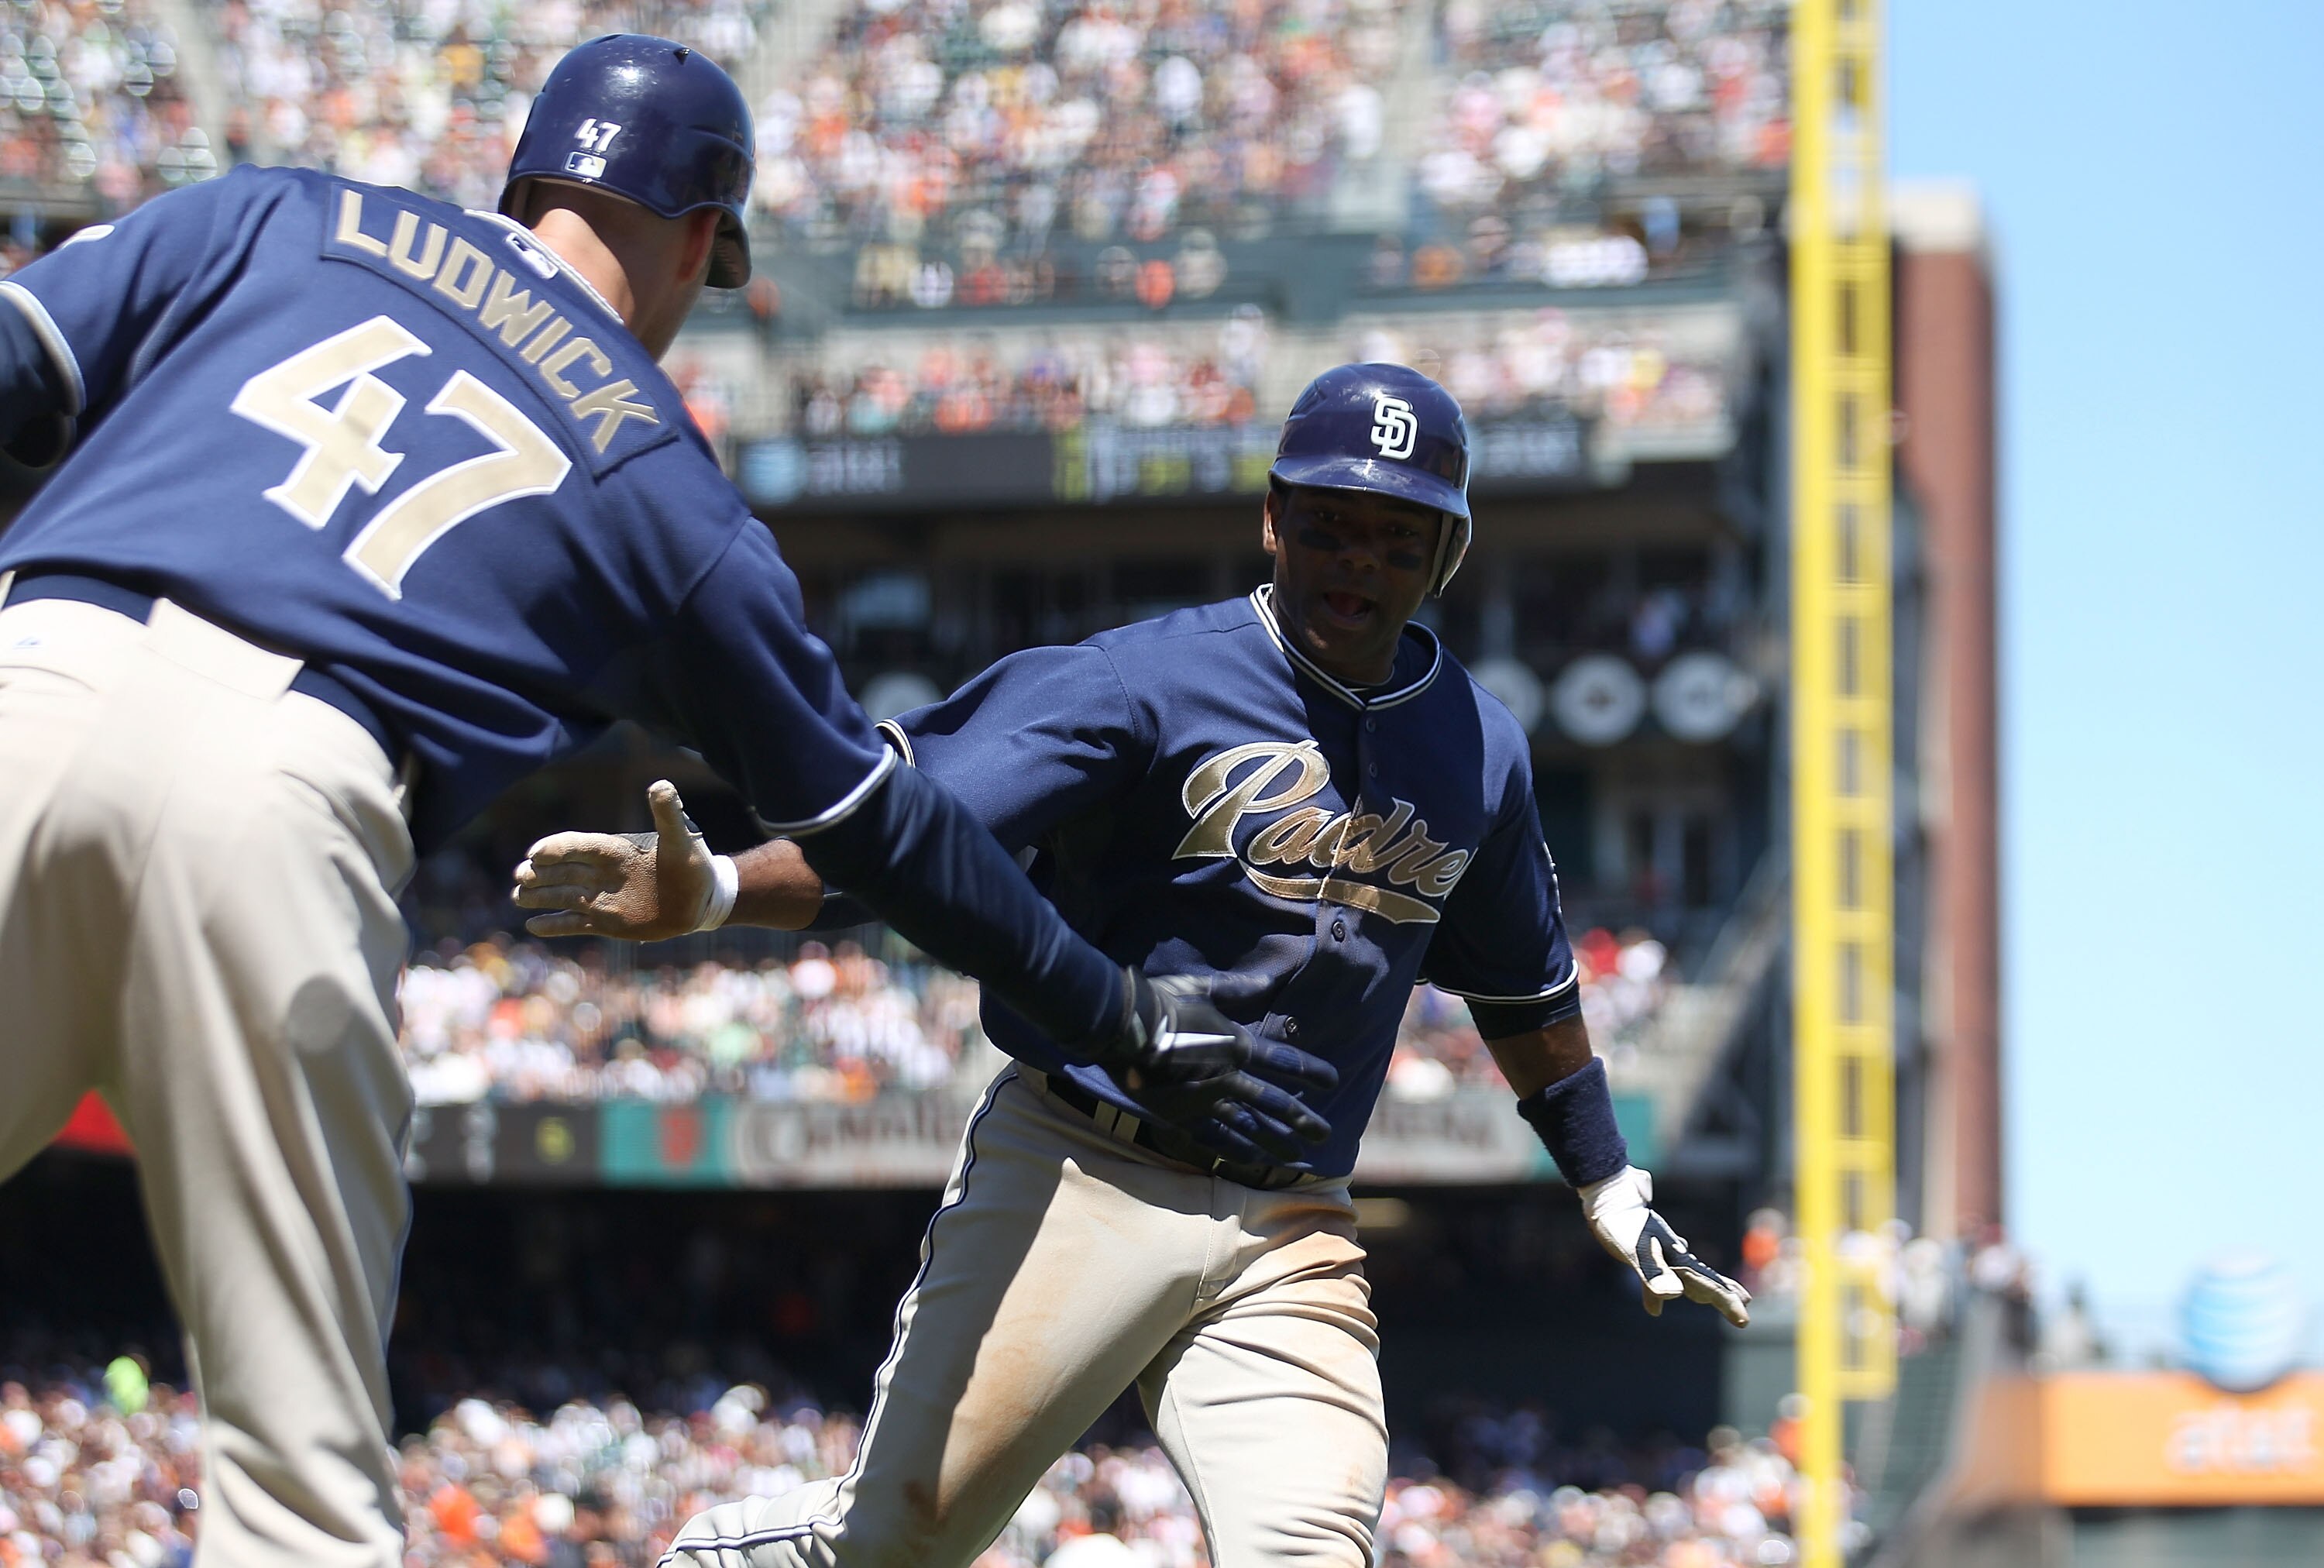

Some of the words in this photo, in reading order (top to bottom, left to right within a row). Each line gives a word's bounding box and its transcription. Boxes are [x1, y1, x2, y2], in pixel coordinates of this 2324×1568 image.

[575, 118, 623, 153] 47
[335, 188, 661, 455] LUDWICK
[229, 315, 573, 601] 47
[1370, 394, 1418, 461] SD
